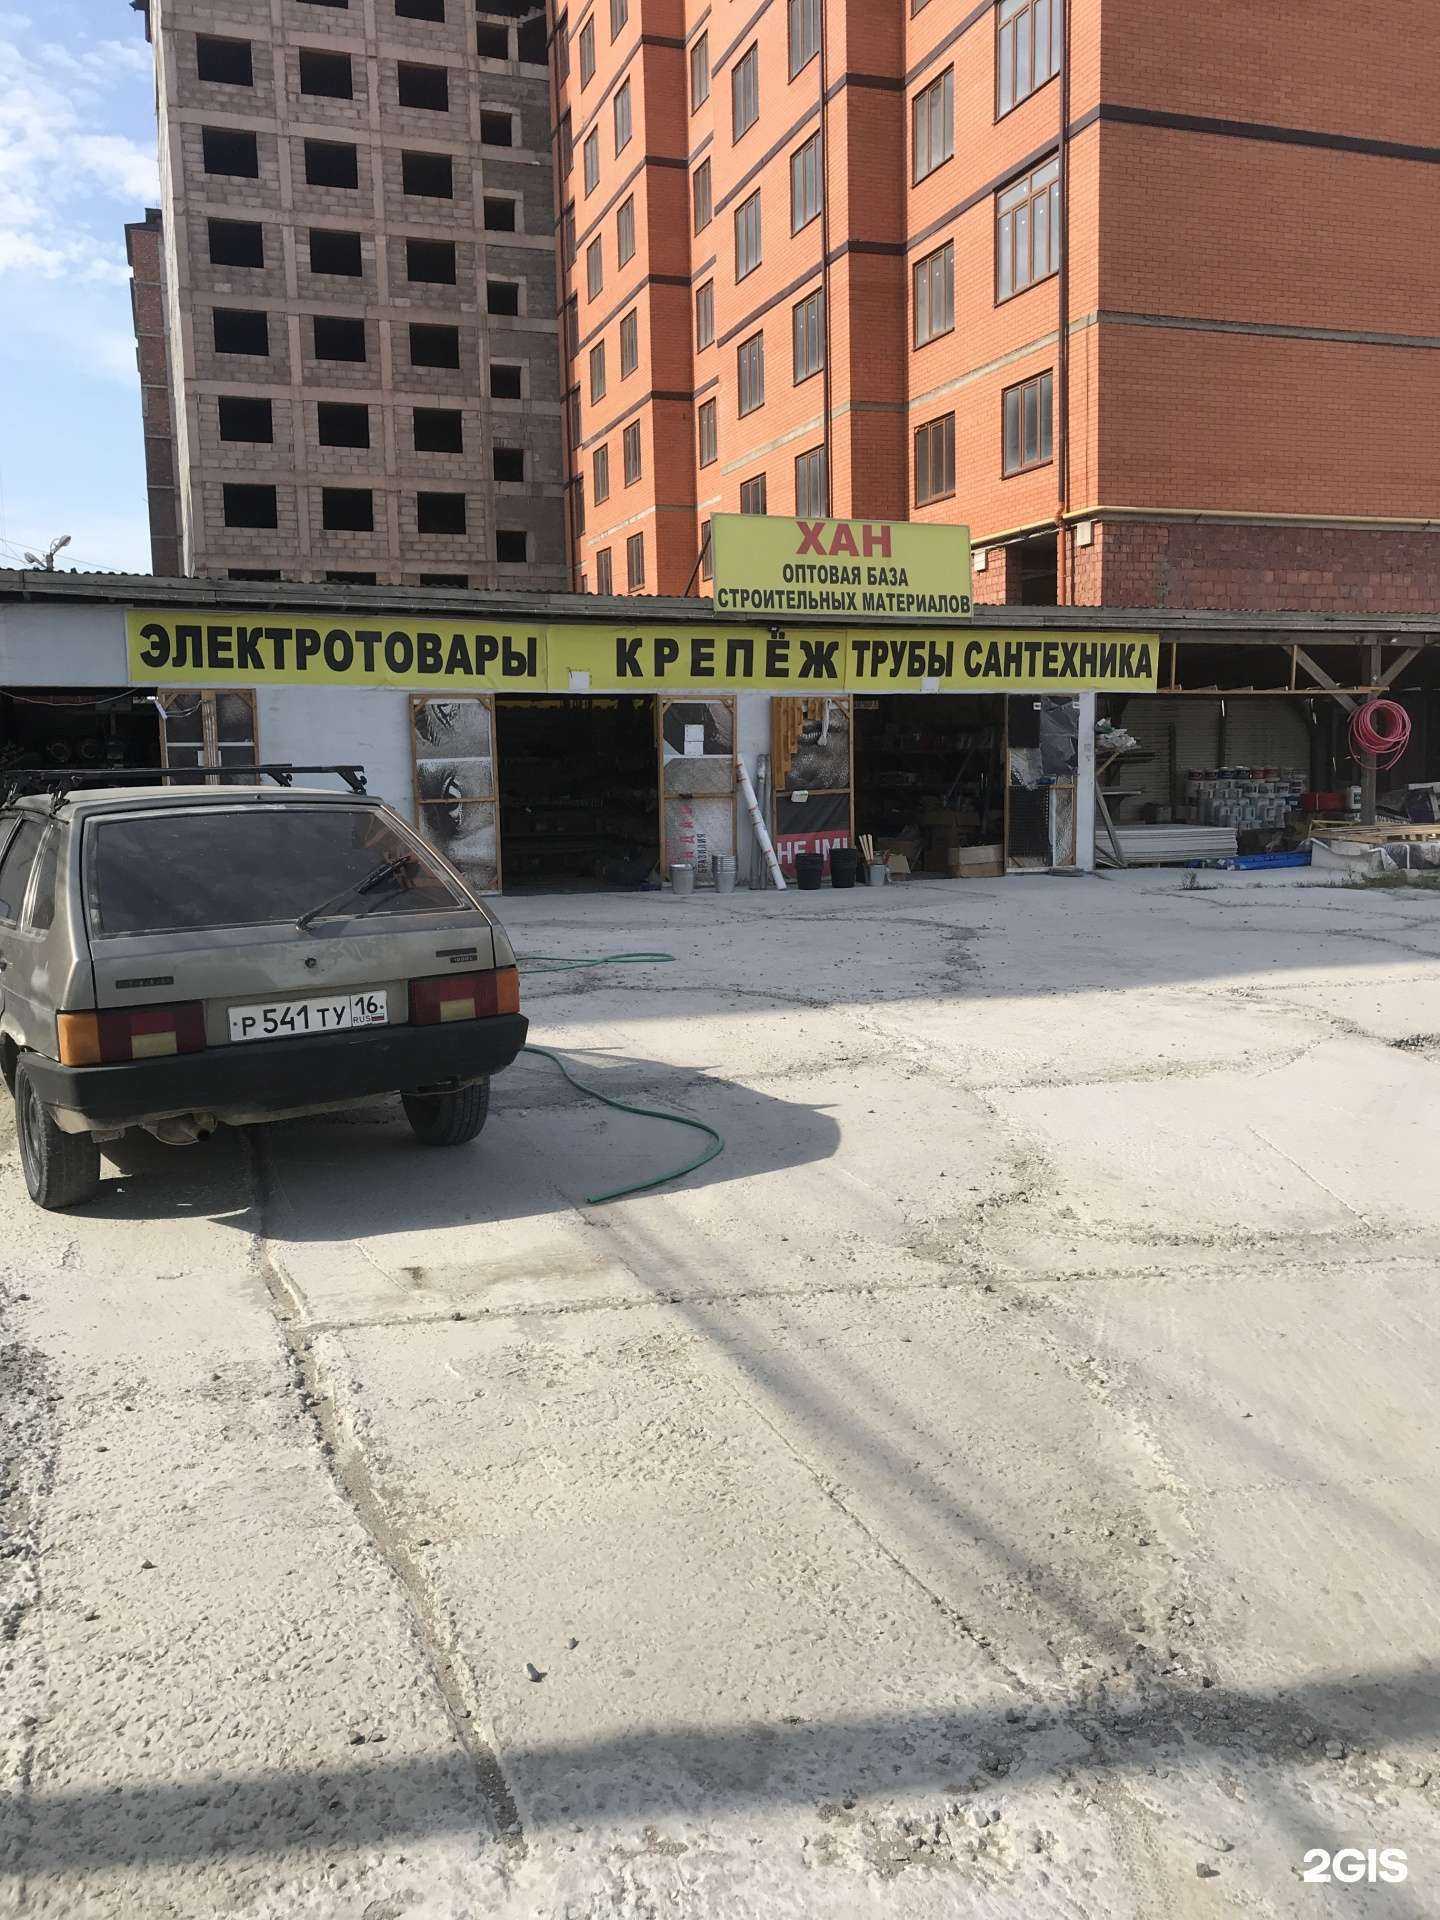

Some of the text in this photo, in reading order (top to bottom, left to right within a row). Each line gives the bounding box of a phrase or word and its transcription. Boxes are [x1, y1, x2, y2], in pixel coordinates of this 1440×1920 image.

[796, 521, 891, 557] ХАН
[783, 564, 908, 586] ОПТОВАЯ БАЗА
[717, 588, 970, 613] СТРОИТЕЛЬНЫХ МАТЕРИАЛОВ
[139, 624, 537, 677] ЭЛЕКТРОТОВАРЫ
[616, 632, 839, 678] КРЕПЁЖ
[852, 640, 1152, 678] ТРУБЫ САНТЕХНИКА
[353, 1015, 371, 1023] RUS
[355, 996, 377, 1015] 16
